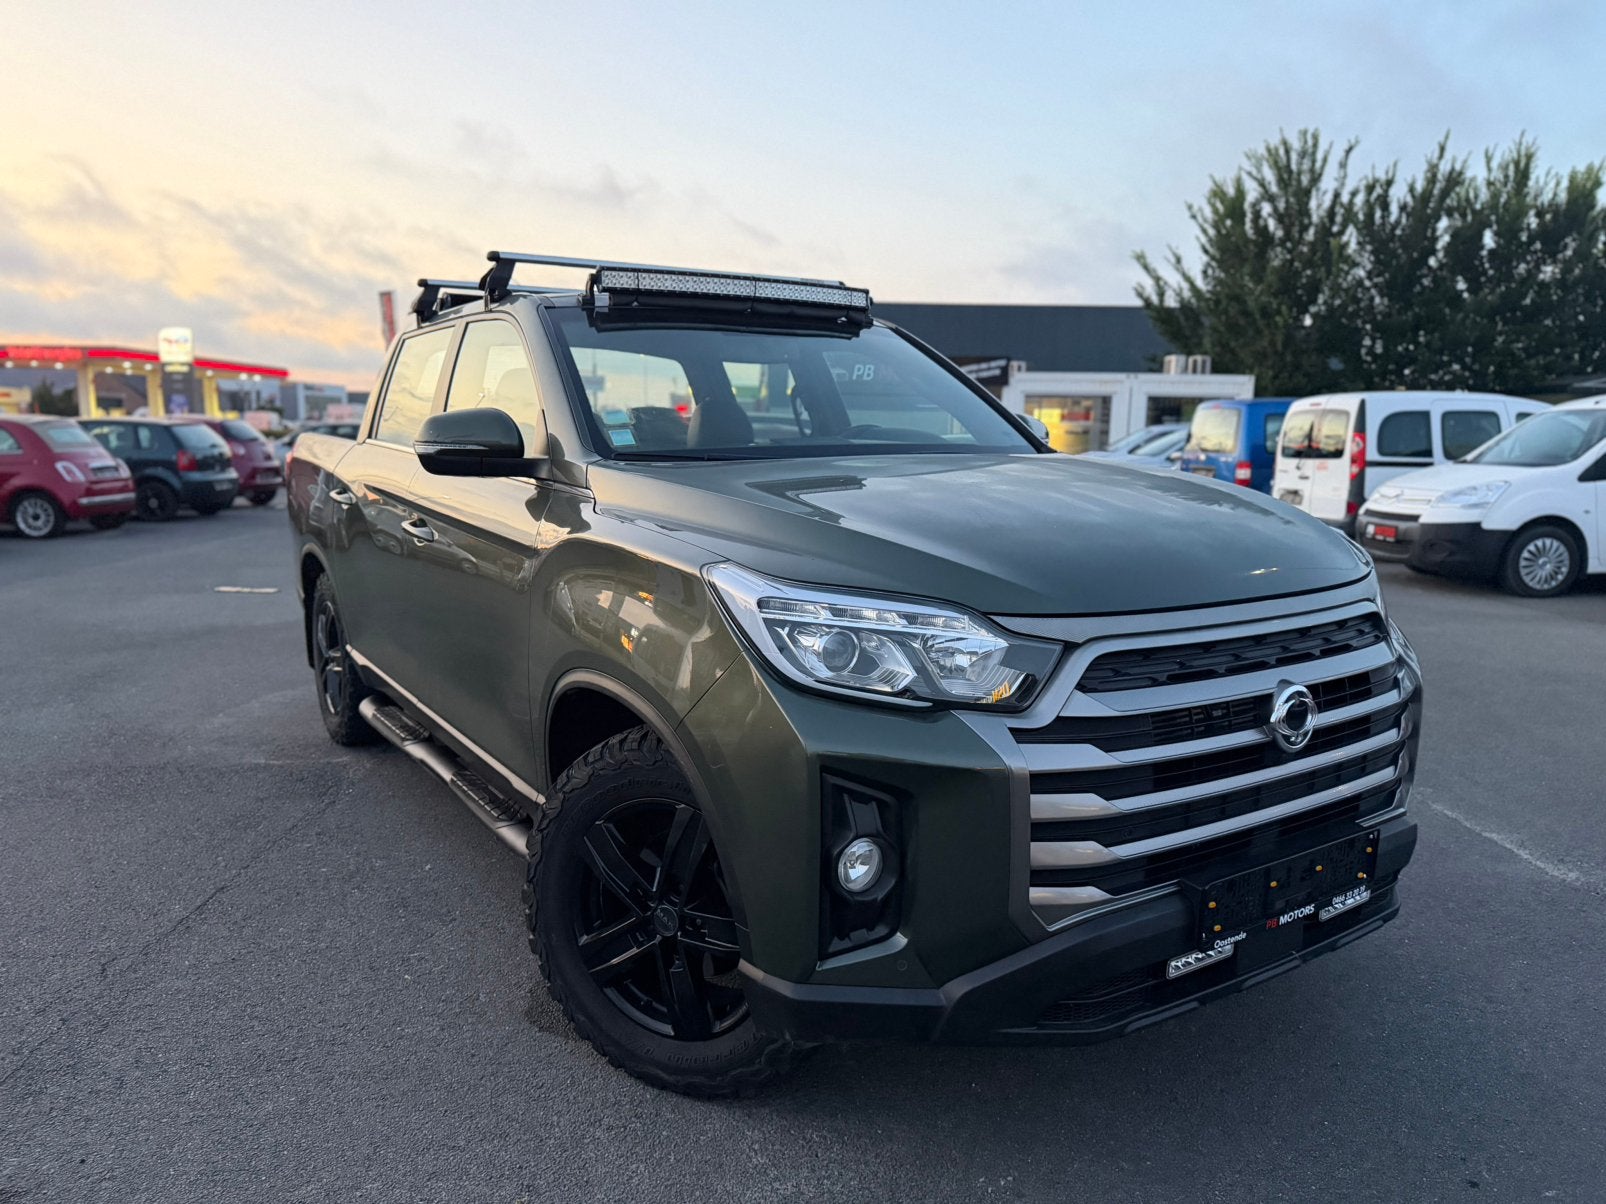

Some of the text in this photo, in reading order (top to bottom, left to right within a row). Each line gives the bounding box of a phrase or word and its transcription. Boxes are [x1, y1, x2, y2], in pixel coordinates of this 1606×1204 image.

[852, 364, 875, 381] PB
[1266, 903, 1315, 930] PB MOTORS
[1214, 931, 1247, 948] Oostende
